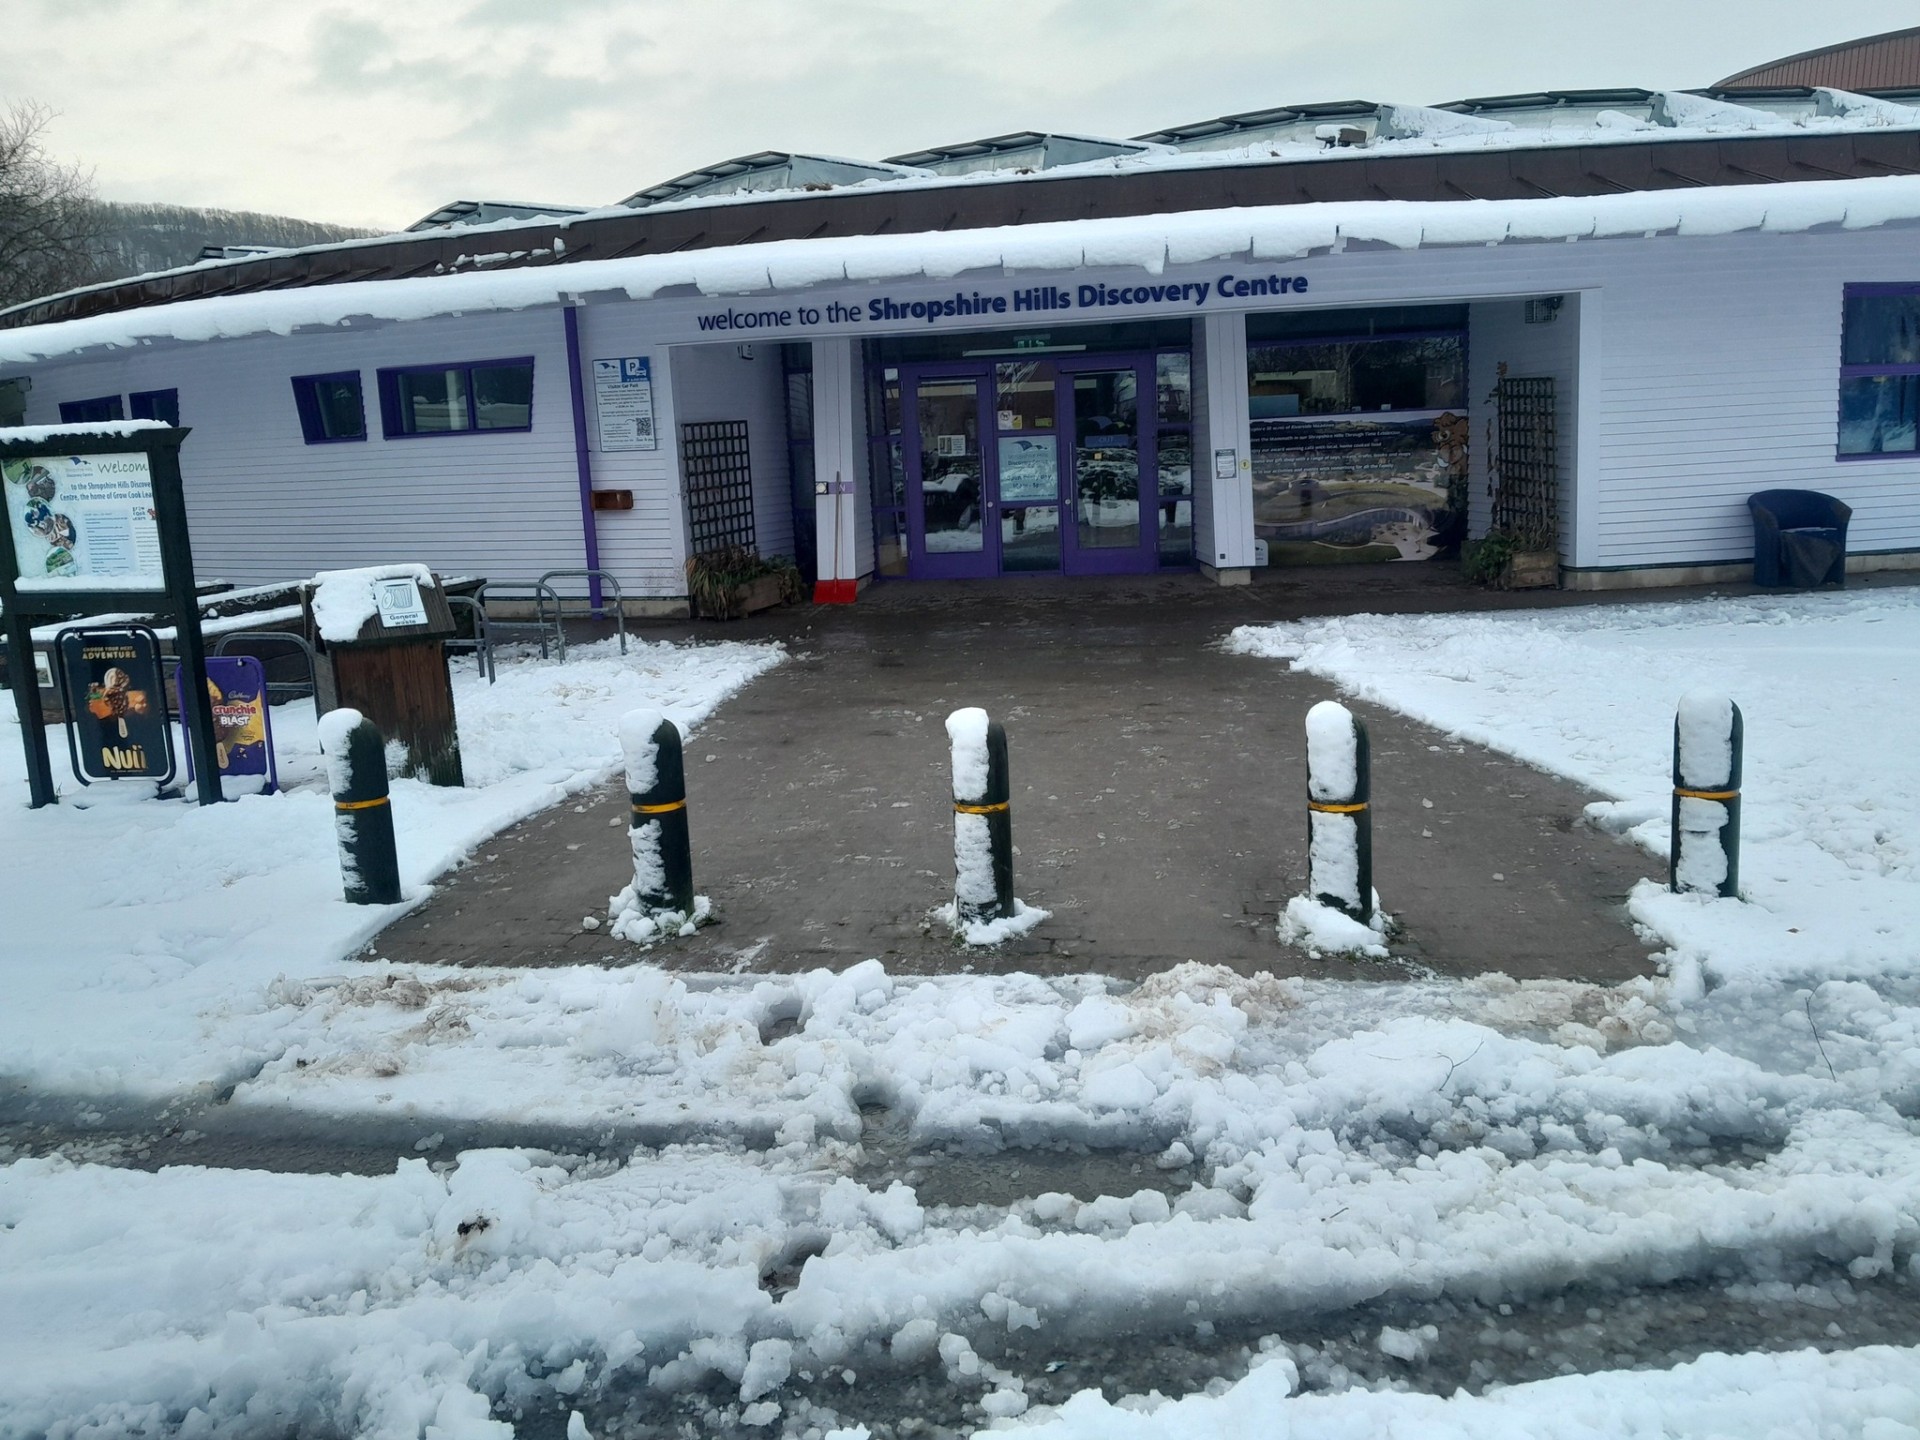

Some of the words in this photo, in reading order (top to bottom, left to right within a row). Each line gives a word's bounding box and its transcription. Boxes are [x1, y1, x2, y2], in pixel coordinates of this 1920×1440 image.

[697, 307, 792, 332] welcome
[797, 307, 820, 326] to
[826, 301, 862, 324] the
[868, 291, 1007, 323] Shropshire
[1013, 286, 1071, 312] Hills
[1077, 281, 1211, 307] Discovery
[1216, 273, 1309, 299] Centre
[629, 361, 636, 373] P
[97, 460, 149, 474] Welcom
[88, 481, 117, 490] Shropshire
[117, 480, 130, 489] Hills
[131, 480, 152, 488] Discove
[90, 492, 106, 500] home
[113, 491, 127, 499] Grow
[127, 490, 142, 498] Cook
[142, 490, 153, 498] Lea
[82, 650, 137, 660] ADVENTURE
[212, 704, 257, 715] crunchie
[220, 716, 250, 726] BLAST
[101, 744, 147, 770] Nuii
